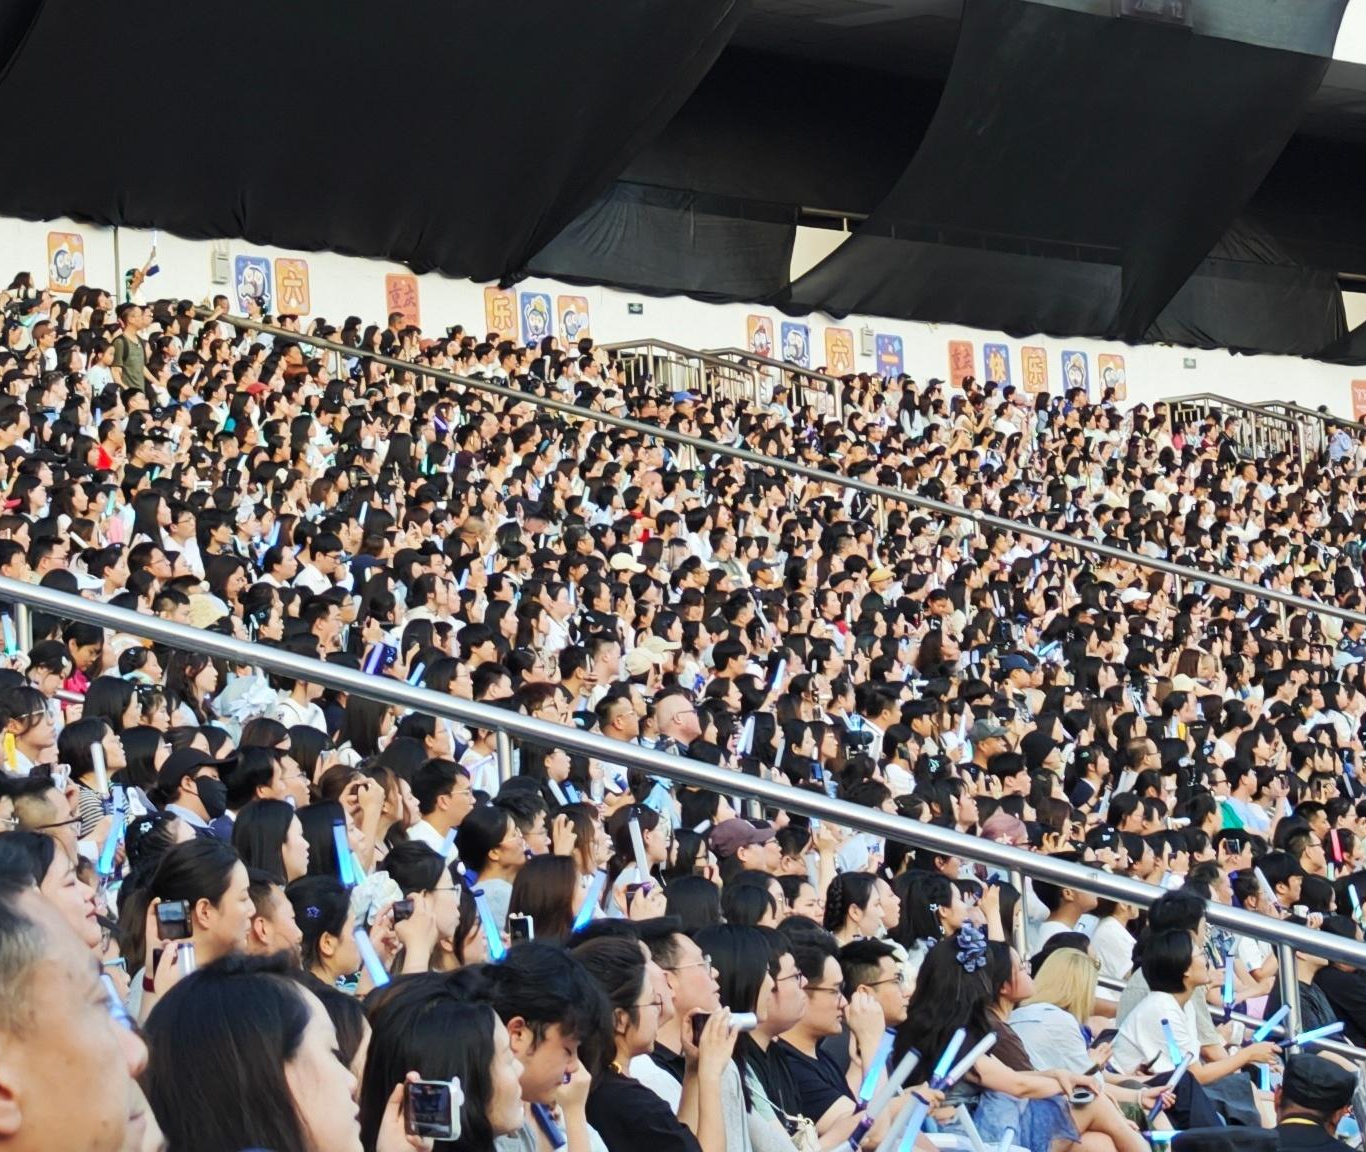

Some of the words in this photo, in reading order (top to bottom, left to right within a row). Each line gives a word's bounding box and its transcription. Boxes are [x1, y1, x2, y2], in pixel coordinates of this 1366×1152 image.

[282, 269, 304, 305] 六
[493, 297, 513, 331] 乐
[831, 336, 849, 368] 六
[1028, 356, 1044, 385] 乐
